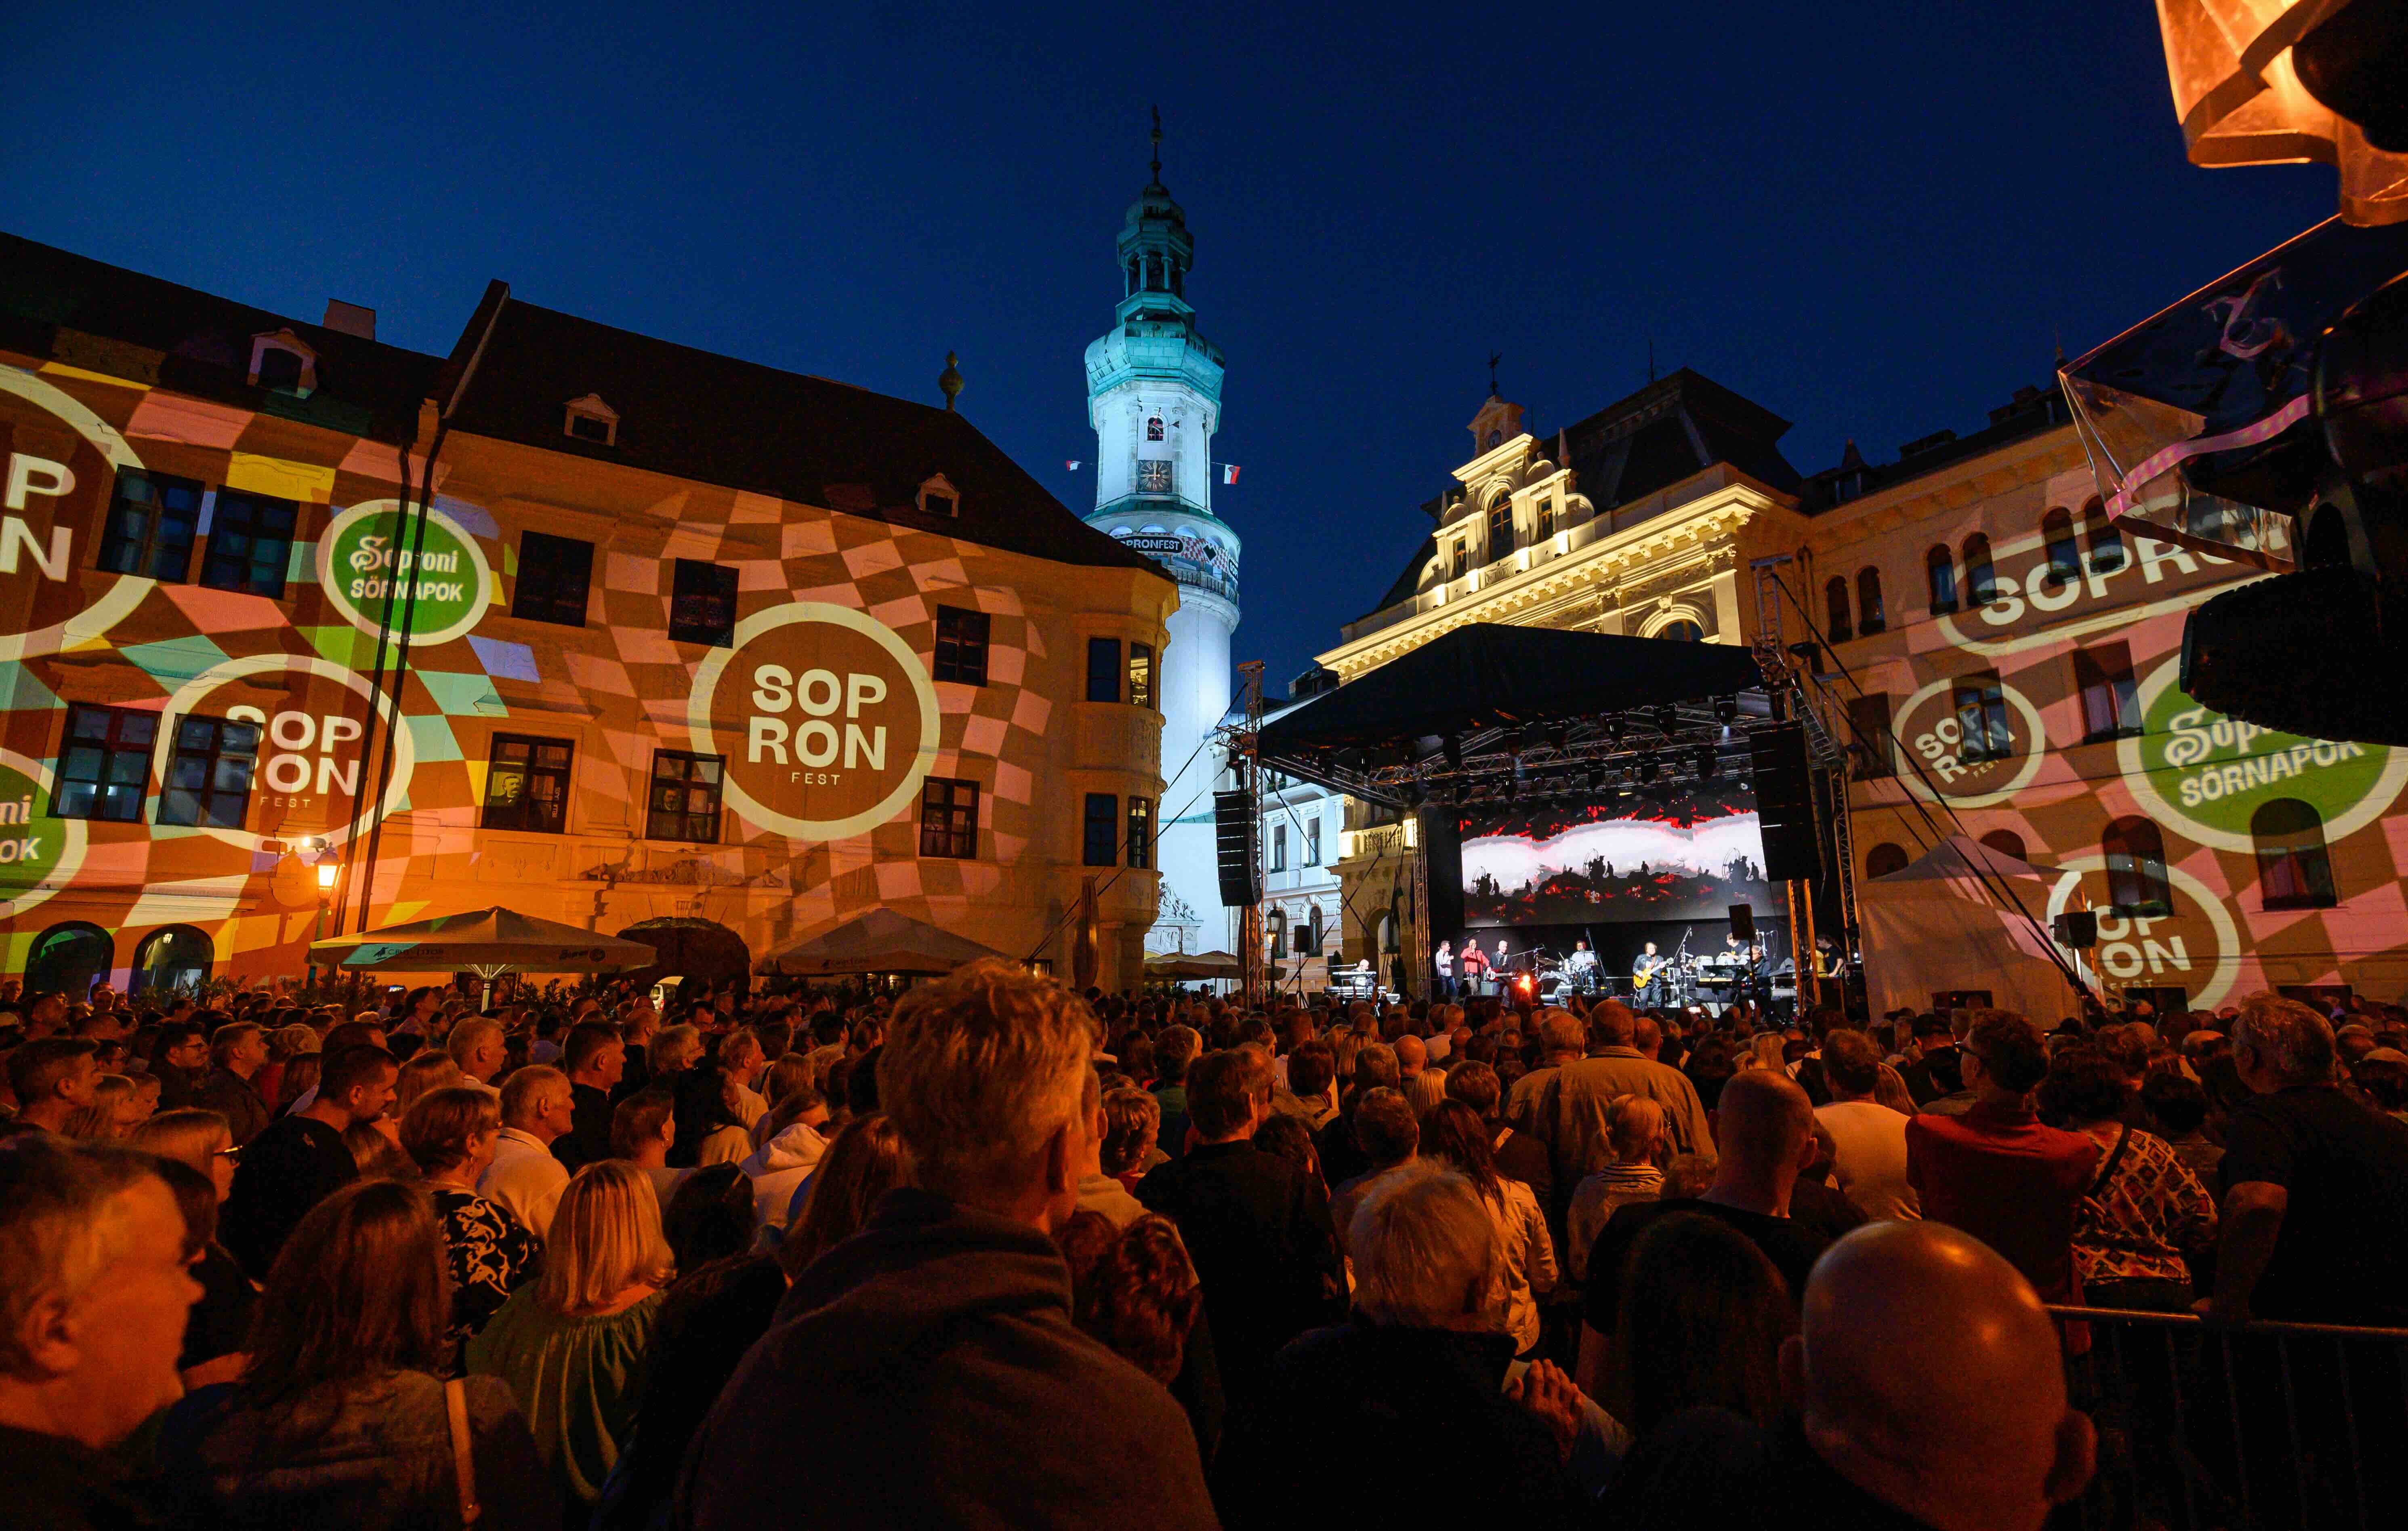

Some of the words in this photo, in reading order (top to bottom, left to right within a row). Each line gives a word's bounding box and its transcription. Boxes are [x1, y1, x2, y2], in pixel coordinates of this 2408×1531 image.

[350, 536, 458, 576] Soponi
[1120, 539, 1179, 550] PRONFEST
[752, 664, 887, 718] SOP
[748, 716, 886, 770] RON
[252, 754, 360, 796] ON
[791, 772, 840, 785] FEST
[261, 797, 311, 808] FEST
[2101, 936, 2192, 978] ON
